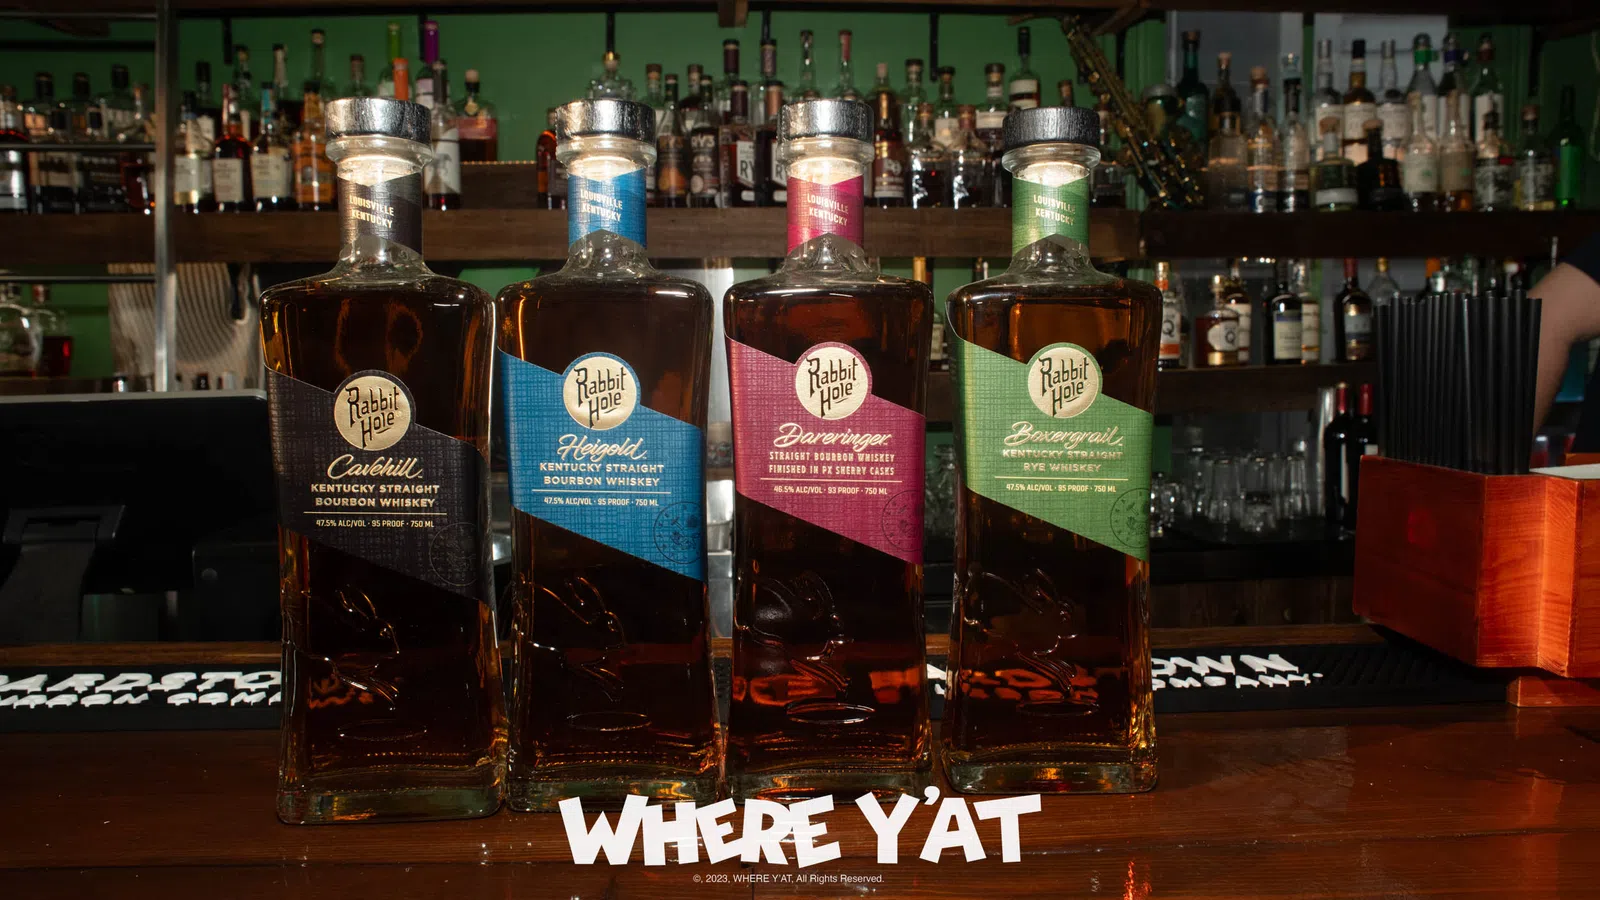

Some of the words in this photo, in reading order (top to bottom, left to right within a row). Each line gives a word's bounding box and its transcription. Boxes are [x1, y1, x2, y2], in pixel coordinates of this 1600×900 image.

[349, 194, 395, 216] LOUISVILLE
[581, 188, 623, 210] LOUISVILLE
[807, 193, 849, 214] LOUISVILLE
[1033, 193, 1076, 214] LOUISVILLE
[351, 208, 393, 228] KENTUCKY
[582, 203, 621, 222] KENTUCKY
[809, 207, 848, 227] KENTUCKY
[1035, 207, 1074, 226] KENTUCKY
[574, 367, 627, 407] Rabbit
[806, 357, 858, 398] Rabbit
[1039, 357, 1089, 397] Rabbit
[345, 386, 400, 427] Rabbit
[820, 382, 853, 417] Hole
[1052, 381, 1084, 417] Hole
[589, 392, 621, 428] Hole
[361, 411, 395, 448] Hole
[774, 423, 892, 452] Dareringer
[1004, 421, 1123, 449] Boxergrail
[557, 434, 647, 462] Heigold
[770, 452, 810, 461] STRAIGHT
[814, 453, 854, 461] BOURBON
[858, 453, 894, 462] WHISKEY
[1003, 450, 1063, 459] KENTUCKY
[1068, 451, 1123, 460] STRAIGHT
[327, 454, 423, 479] Cavehill
[540, 463, 602, 472] KENTUCKY
[606, 464, 664, 473] STRAIGHT
[769, 465, 806, 474] FINISHED
[810, 466, 818, 474] IN
[822, 466, 833, 474] PX
[836, 466, 866, 475] SHERRY
[870, 467, 894, 476] CASKS
[1024, 463, 1045, 471] RYE
[1050, 464, 1101, 472] WHISKEY
[311, 484, 375, 493] KENTUCKY
[380, 485, 440, 494] STRAIGHT
[544, 477, 601, 485] BOURBON
[606, 478, 660, 486] WHISKEY
[796, 486, 822, 494] ALC/VOL
[1107, 485, 1116, 493] ML
[316, 498, 375, 507] BOURBON
[380, 498, 435, 507] WHISKEY
[649, 499, 659, 507] ML
[0, 671, 281, 694] ARDSTO
